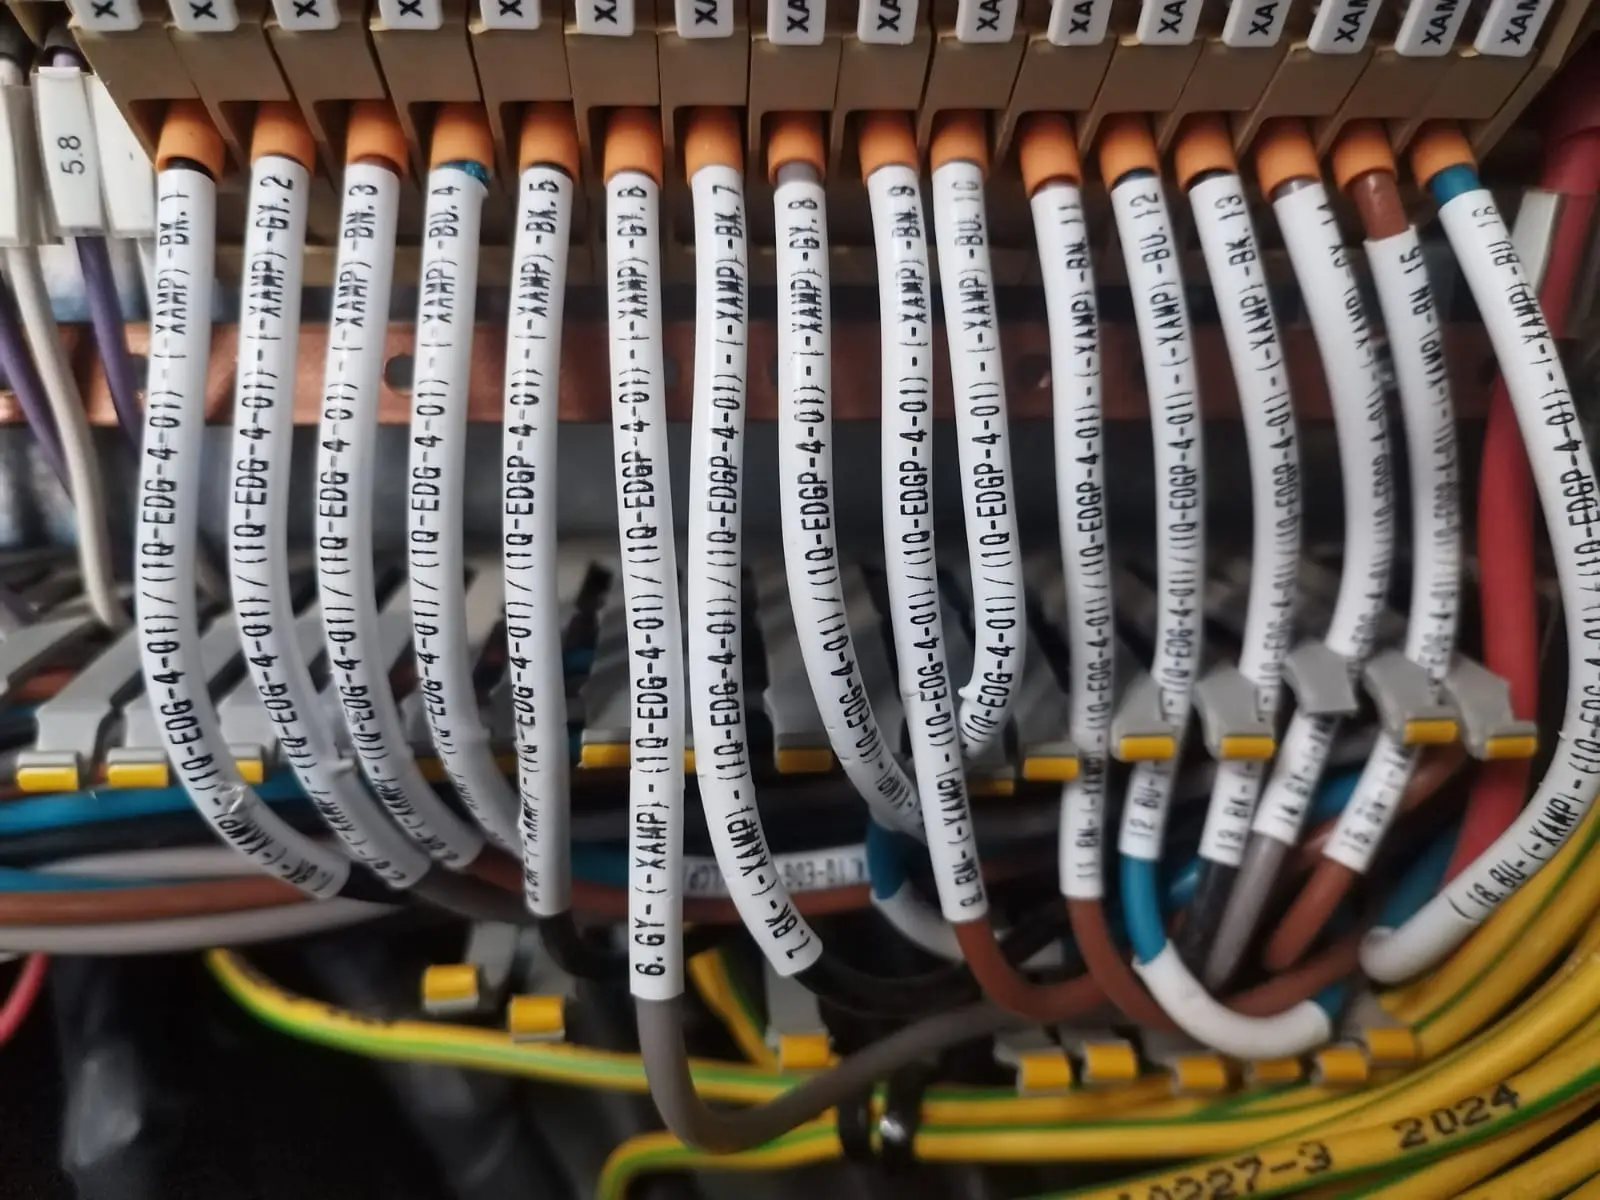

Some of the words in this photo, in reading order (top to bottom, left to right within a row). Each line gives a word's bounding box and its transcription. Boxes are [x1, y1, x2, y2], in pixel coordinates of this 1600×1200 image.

[595, 0, 617, 24] X
[1249, 2, 1278, 36] XA
[57, 135, 86, 175] 5.8
[1118, 1140, 1332, 1200] 227-3
[1391, 1083, 1519, 1148] 2024
